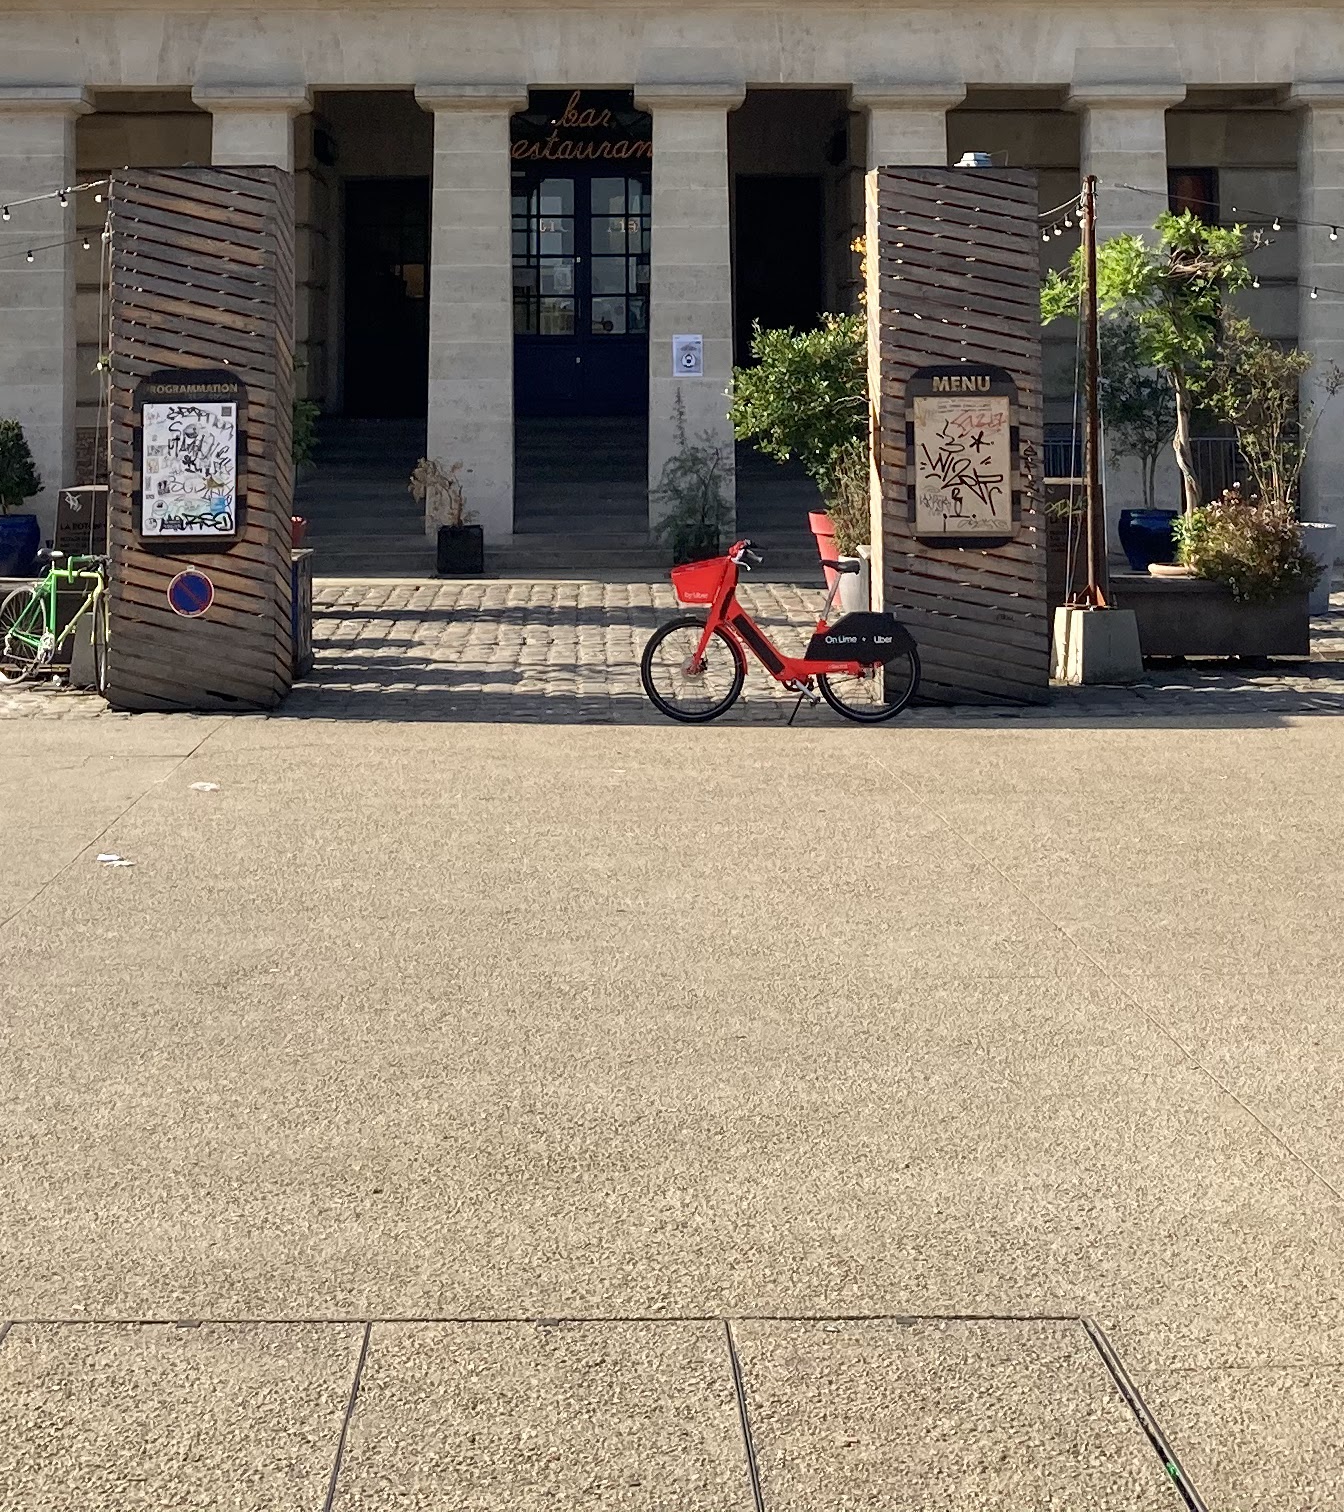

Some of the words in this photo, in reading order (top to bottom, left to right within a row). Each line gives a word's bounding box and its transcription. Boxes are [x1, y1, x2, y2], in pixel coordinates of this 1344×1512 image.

[556, 90, 613, 128] bar
[511, 128, 654, 160] estauran
[932, 375, 991, 392] MENU
[825, 635, 838, 644] On
[873, 635, 893, 644] Uber
